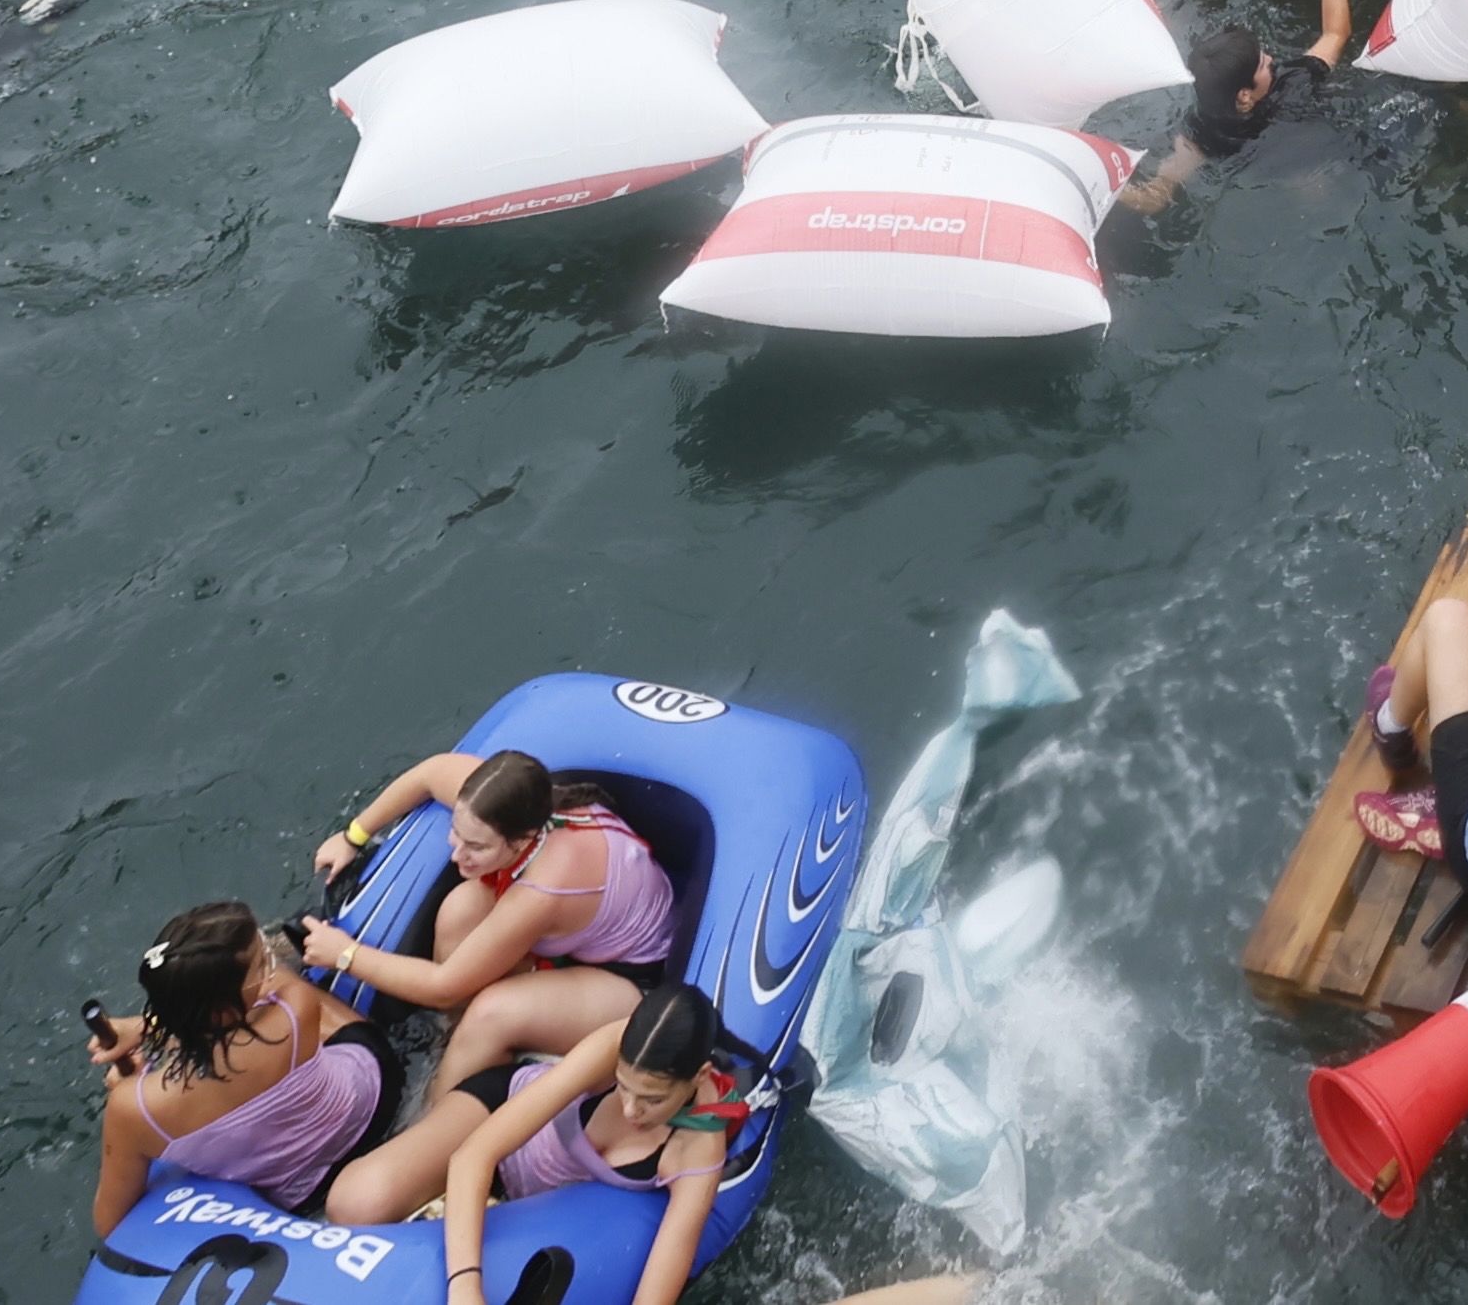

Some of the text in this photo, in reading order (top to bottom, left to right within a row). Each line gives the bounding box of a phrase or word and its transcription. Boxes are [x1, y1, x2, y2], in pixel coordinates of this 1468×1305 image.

[436, 189, 592, 227] cordstrap
[808, 205, 966, 237] cordstrap
[628, 685, 716, 718] 200
[154, 1194, 395, 1283] Bestway
